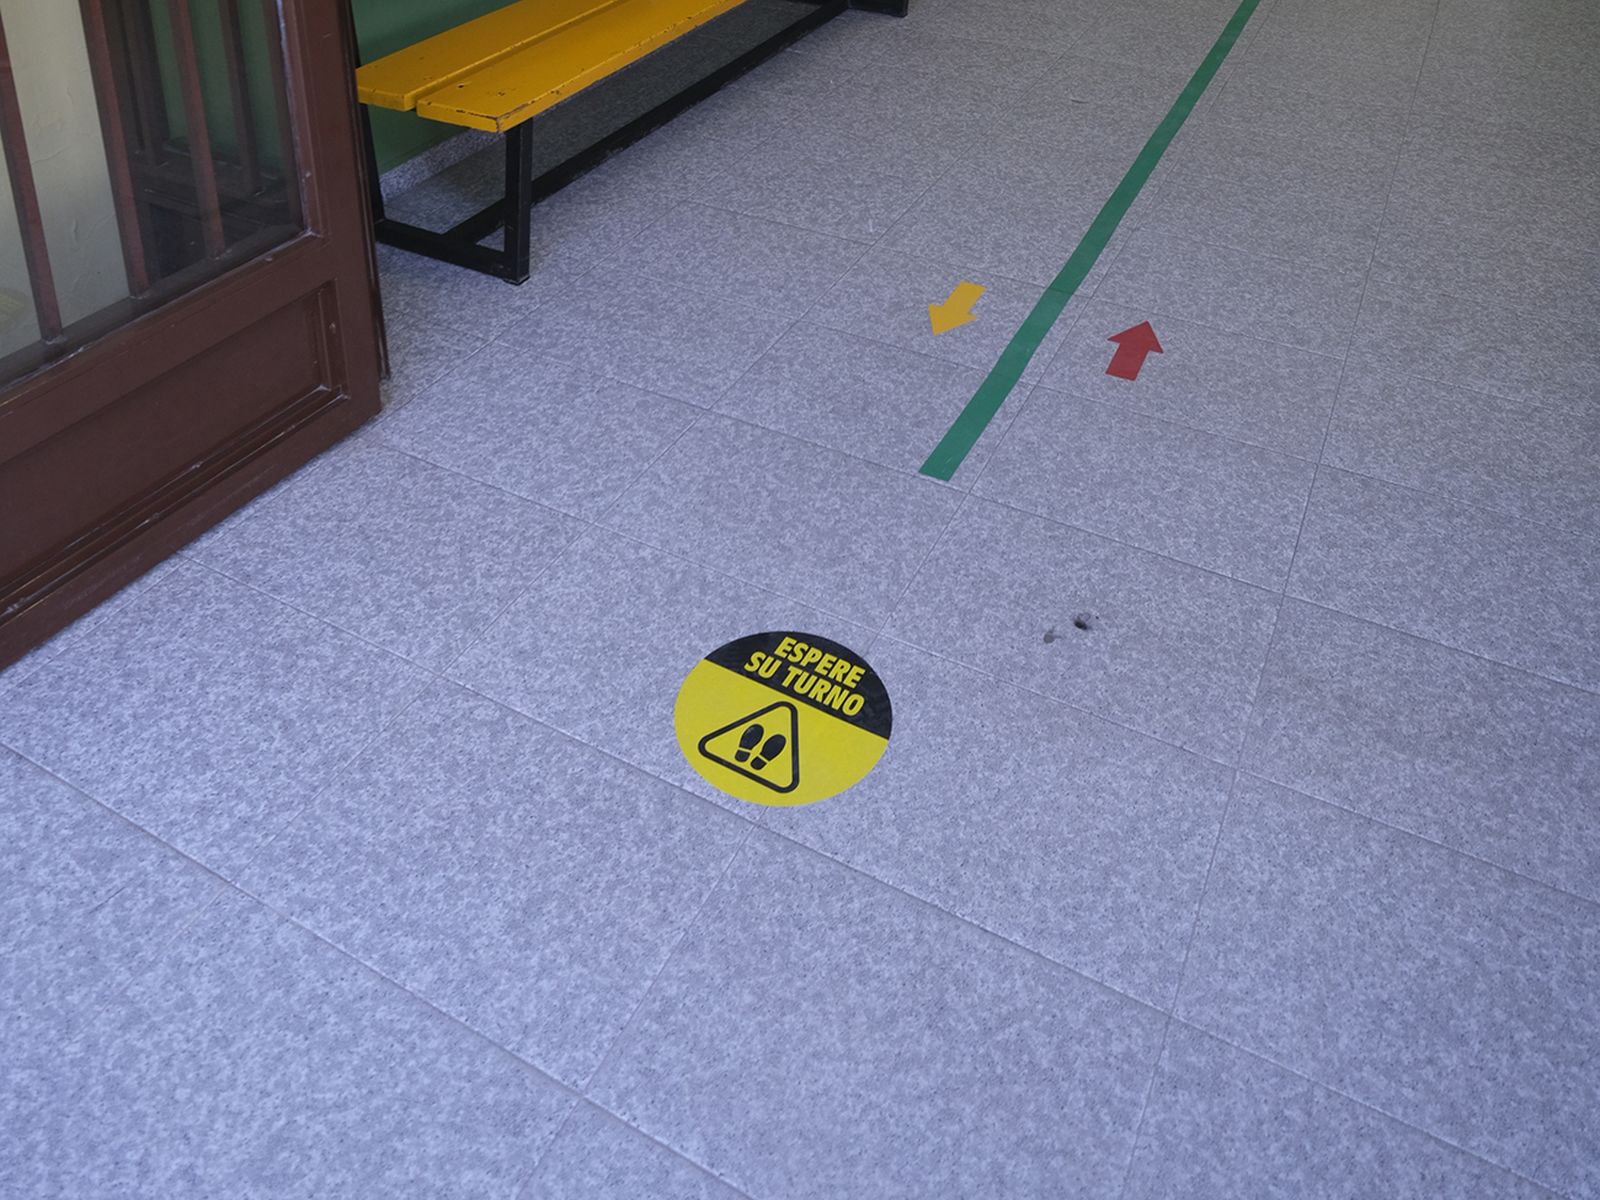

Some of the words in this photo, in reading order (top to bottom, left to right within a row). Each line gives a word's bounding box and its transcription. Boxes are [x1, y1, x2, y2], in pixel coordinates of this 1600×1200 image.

[743, 651, 782, 679] SU
[781, 665, 865, 717] TURNO
[774, 636, 866, 689] ESPERE
